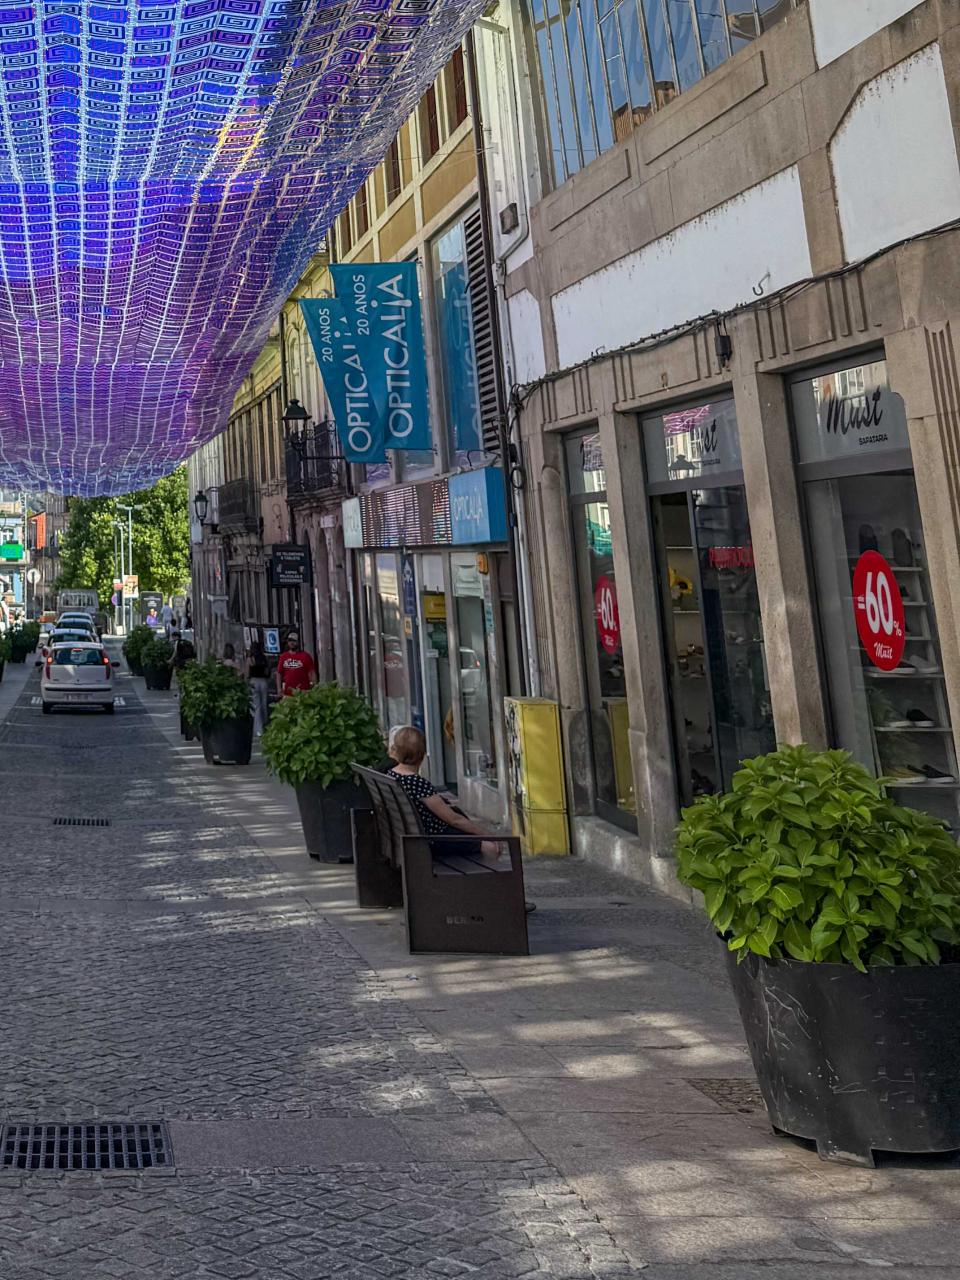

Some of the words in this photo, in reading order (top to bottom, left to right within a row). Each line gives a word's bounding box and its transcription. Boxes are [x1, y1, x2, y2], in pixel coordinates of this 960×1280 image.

[352, 274, 367, 315] ANOS
[319, 308, 332, 345] ANOS
[357, 319, 370, 336] 20
[322, 347, 333, 362] 20
[827, 384, 884, 435] Must
